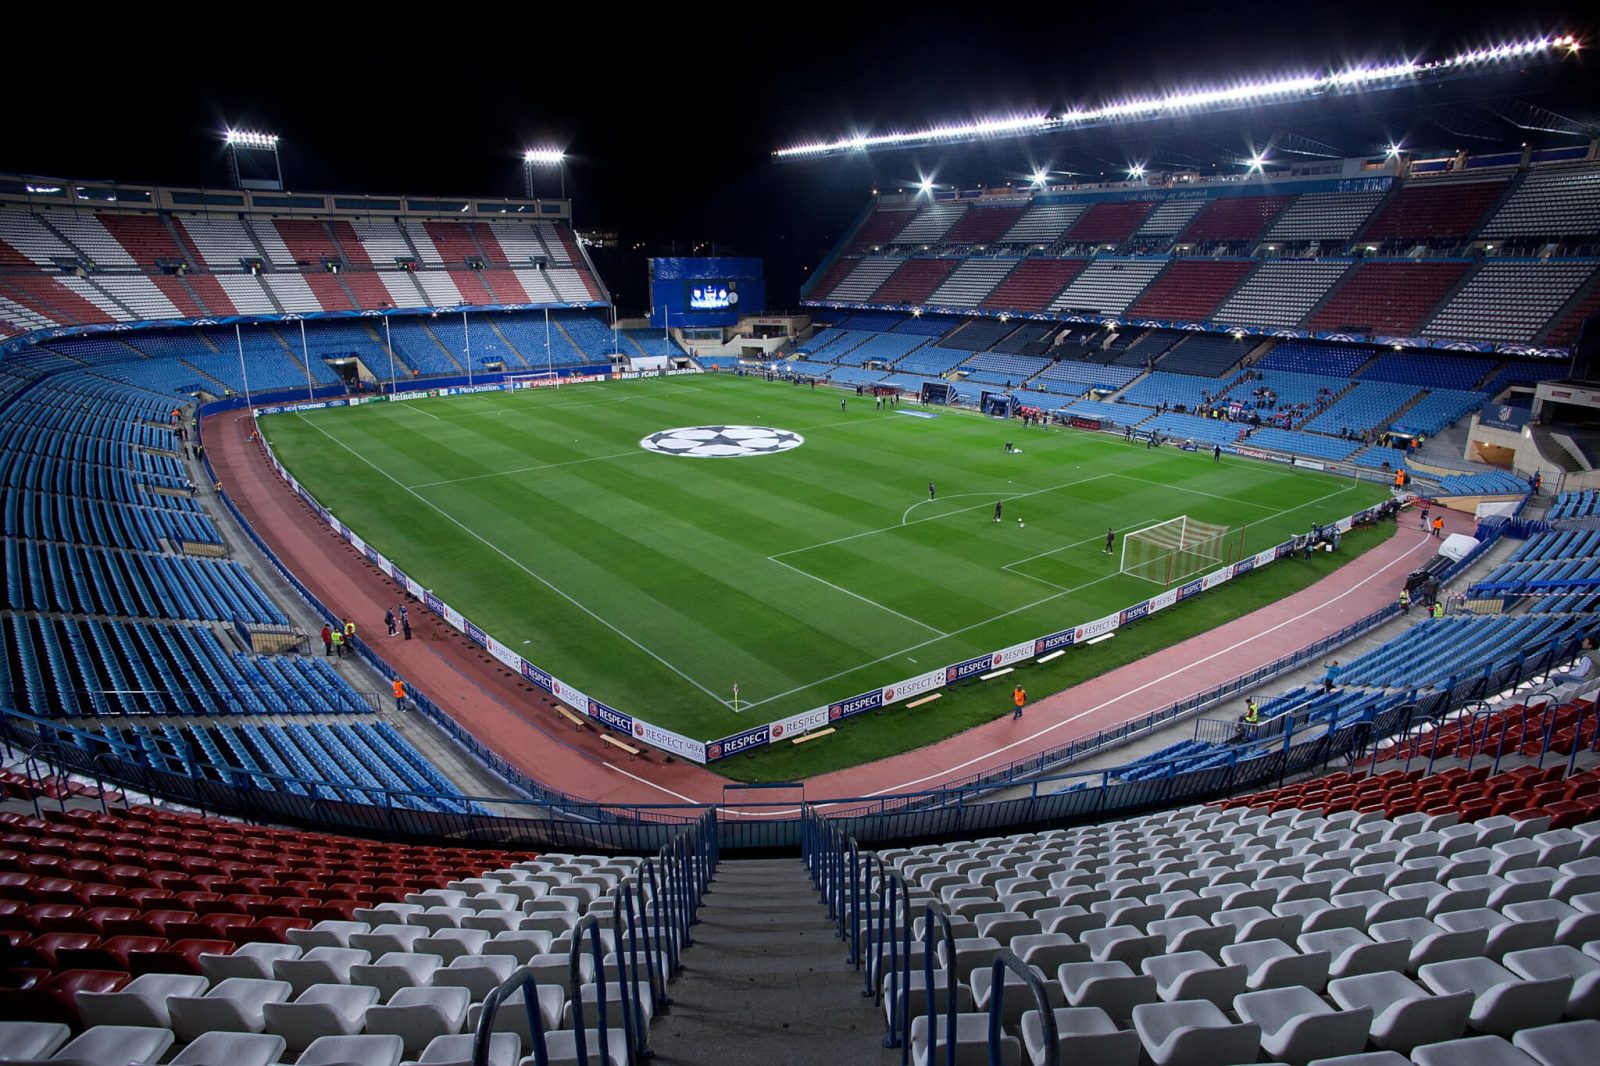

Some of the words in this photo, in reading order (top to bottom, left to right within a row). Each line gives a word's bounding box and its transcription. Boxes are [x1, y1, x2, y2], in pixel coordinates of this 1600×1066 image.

[389, 390, 428, 402] Heineken
[459, 384, 499, 394] PlayStation
[1182, 581, 1202, 596] RESPECT
[1156, 593, 1177, 607] RESPECT
[1126, 605, 1148, 619] RESPECT
[1084, 620, 1111, 636] RESPECT
[1045, 632, 1074, 648] RESPECT
[492, 644, 514, 664] RESPECT
[1004, 644, 1035, 662] RESPECT
[528, 666, 551, 688] RESPECT
[958, 658, 992, 677] RESPECT
[560, 685, 588, 709] RESPECT
[896, 678, 932, 697] RESPECT
[843, 694, 882, 714] RESPECT
[599, 707, 632, 731] RESPECT
[786, 711, 828, 732] RESPECT
[645, 729, 684, 751] RESPECT
[686, 742, 704, 754] UEFA
[724, 730, 769, 752] RESPECT
